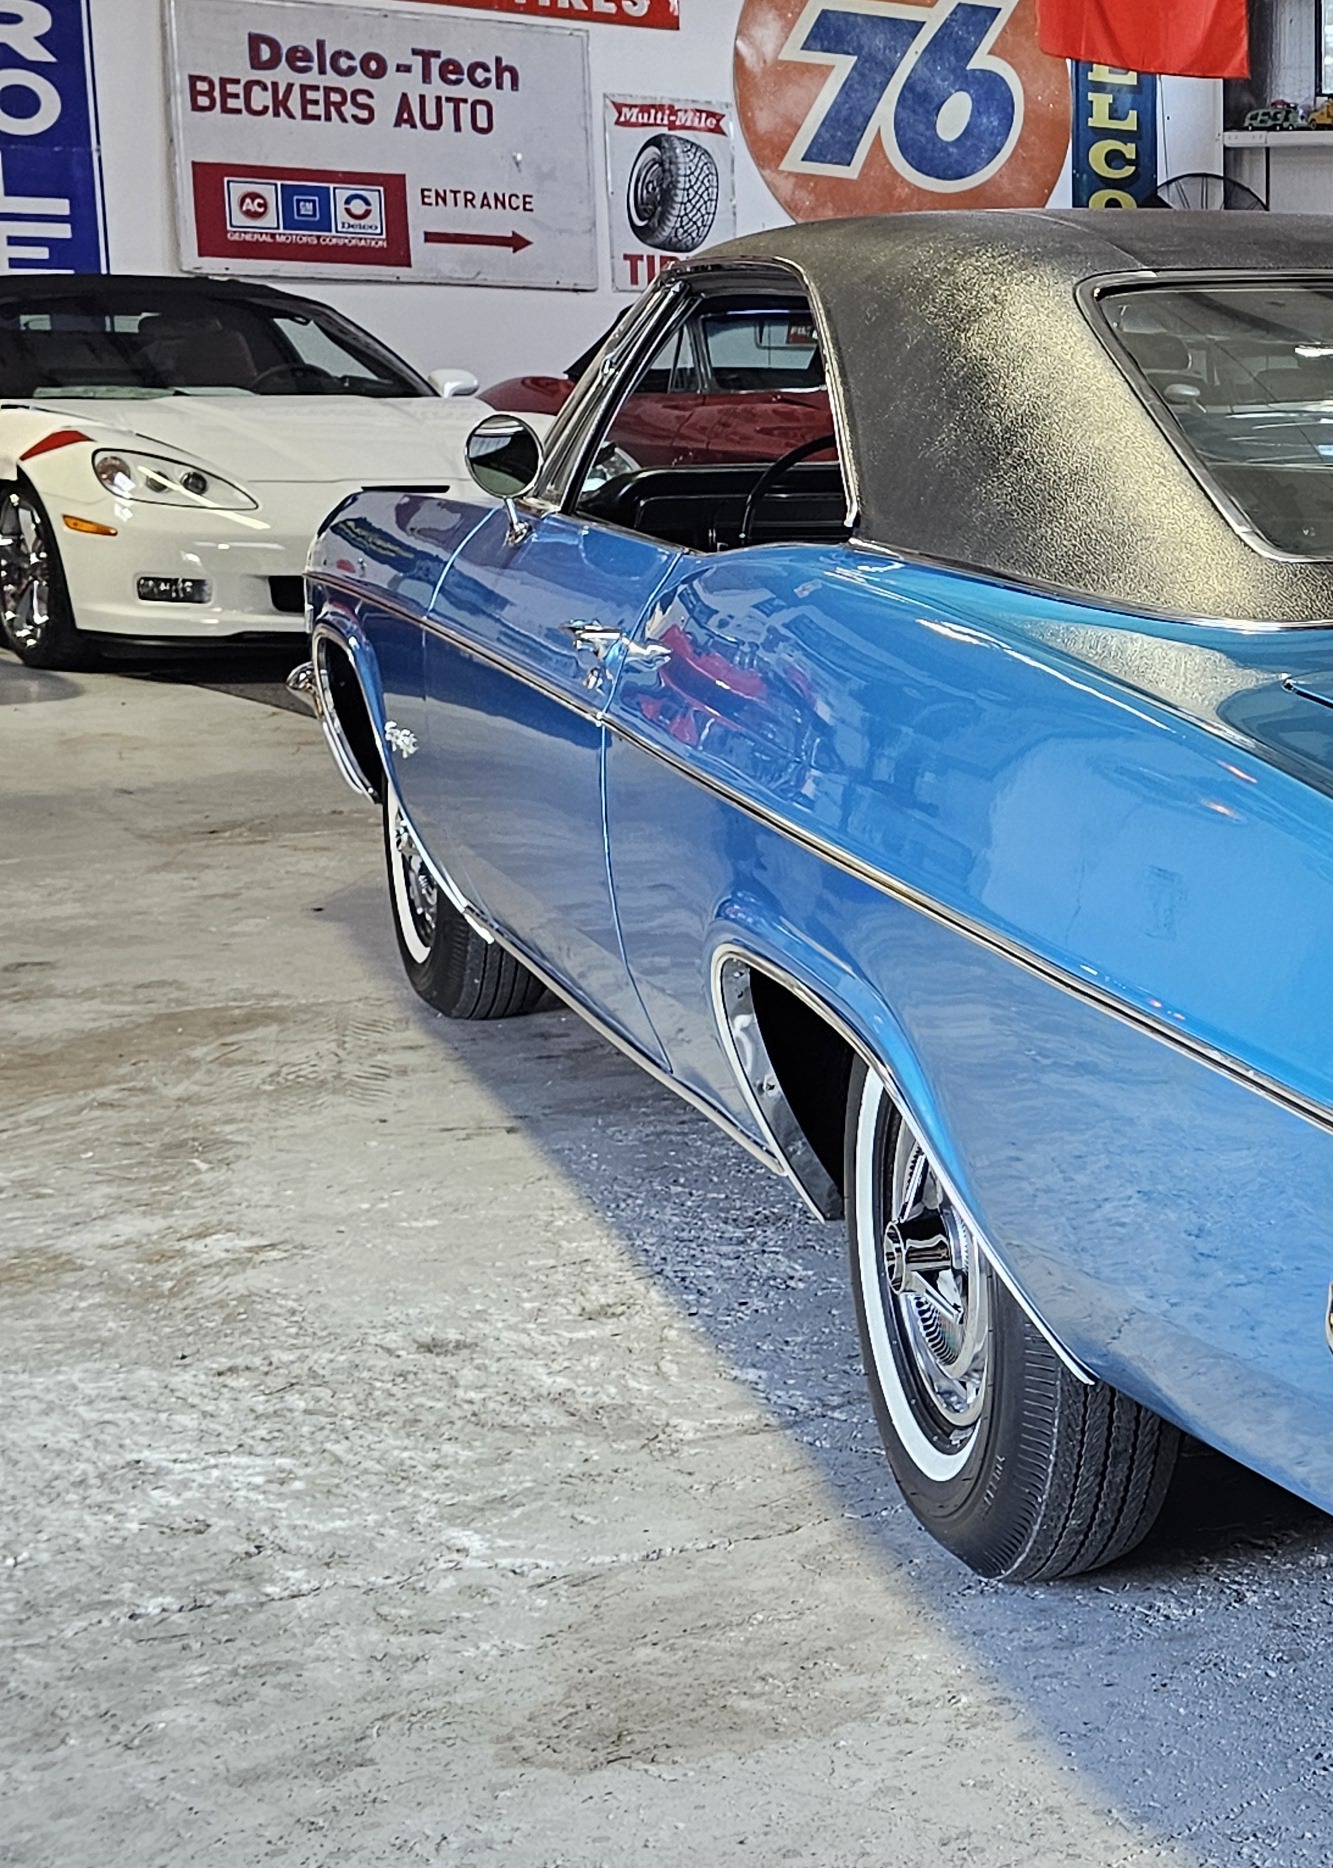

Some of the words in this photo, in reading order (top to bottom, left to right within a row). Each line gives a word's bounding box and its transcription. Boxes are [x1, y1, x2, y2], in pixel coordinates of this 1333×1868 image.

[248, 32, 520, 91] Delco-Tech
[188, 74, 375, 125] BECKERS
[393, 92, 494, 134] AUTO
[779, 0, 1024, 193] 76
[619, 107, 717, 129] Multi-Mile
[242, 198, 265, 213] AC
[300, 201, 313, 215] GM
[421, 188, 534, 212] ENTRANCE
[341, 222, 378, 232] Delco
[227, 232, 273, 242] GENERAL
[275, 234, 318, 245] MOTORS
[320, 236, 387, 248] CORPORATION
